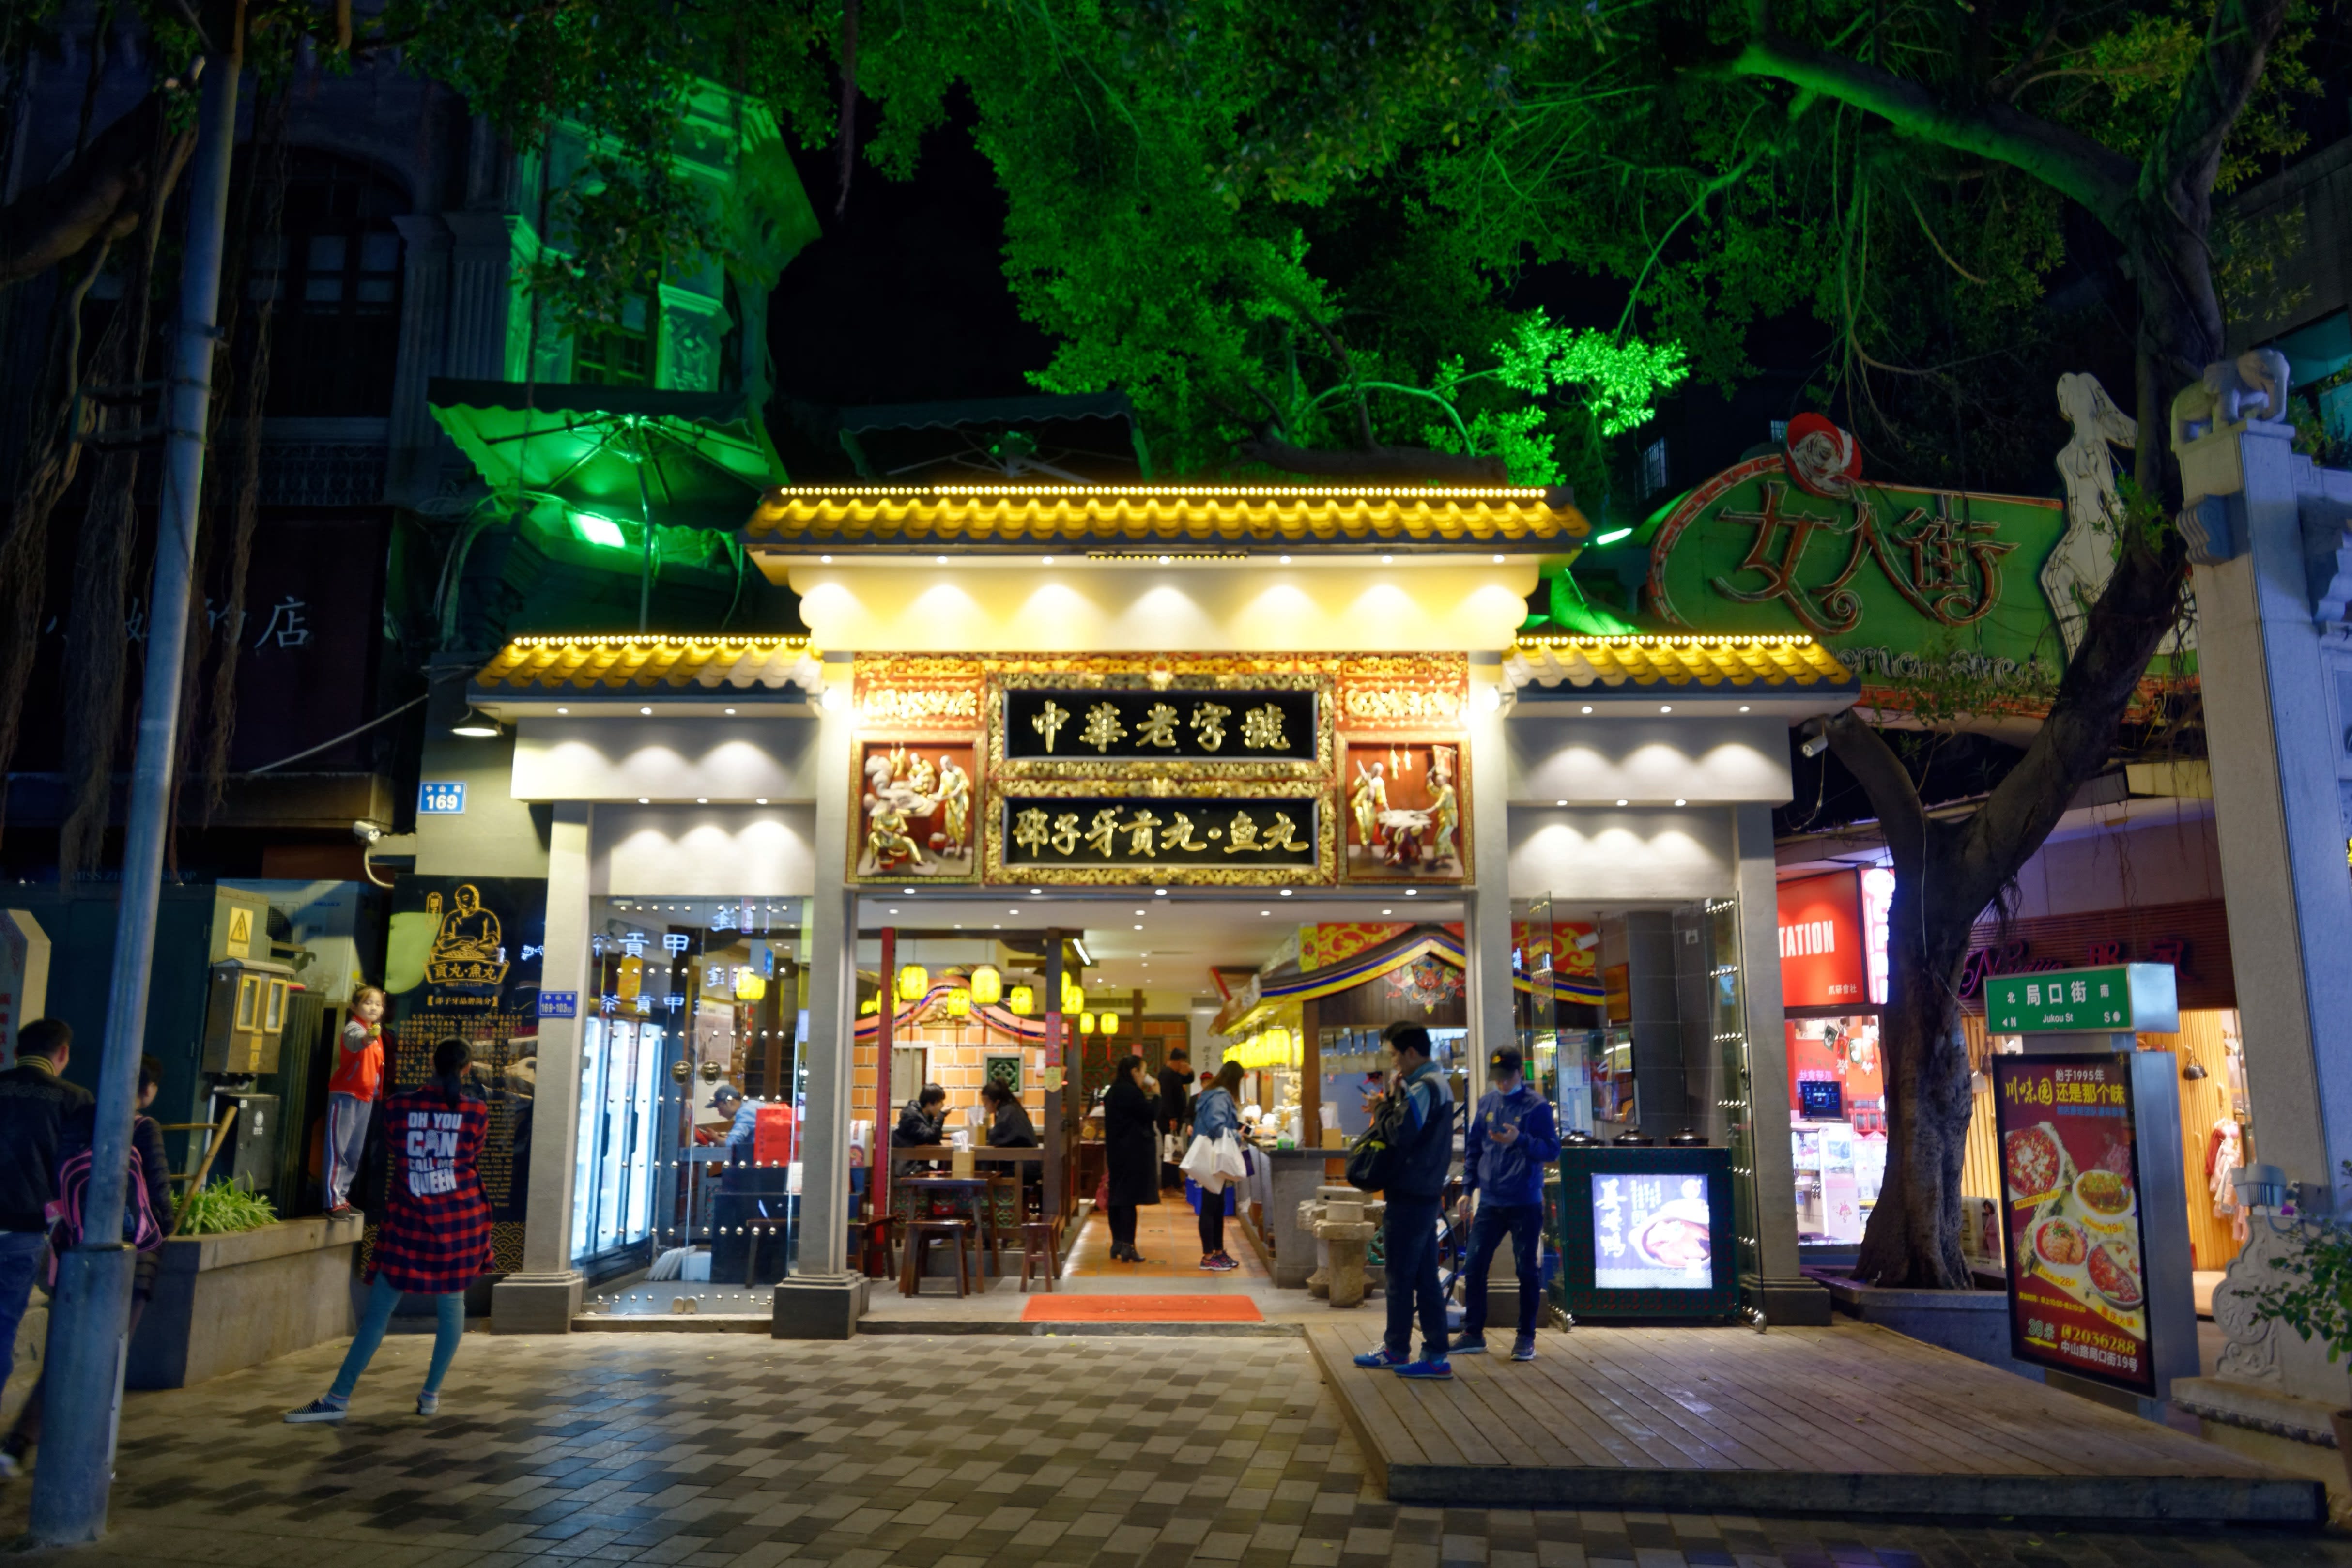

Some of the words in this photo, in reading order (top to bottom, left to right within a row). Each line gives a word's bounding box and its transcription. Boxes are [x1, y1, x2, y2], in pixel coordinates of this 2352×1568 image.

[1711, 480, 2020, 635] 女人街
[1032, 699, 1291, 753] 中華老字號
[426, 795, 458, 809] 169
[2007, 992, 2015, 1004] 北
[2027, 981, 2086, 1006] 局口街
[2100, 984, 2109, 998] 南
[2011, 1017, 2016, 1027] N
[2043, 1014, 2064, 1023] Jukou
[2065, 1013, 2074, 1022] St
[2104, 1011, 2110, 1023] S
[2055, 1069, 2105, 1082] 始于1995年
[2056, 1083, 2125, 1105] 还是那个味
[408, 1112, 428, 1128] OH
[433, 1113, 462, 1129] YOU
[409, 1157, 435, 1171] CALL
[437, 1159, 455, 1169] ME
[409, 1168, 457, 1198] QUEEN
[2028, 1317, 2055, 1340] 38米
[2073, 1325, 2137, 1355] 2036288
[2061, 1340, 2138, 1372] 中山路局口街19号
